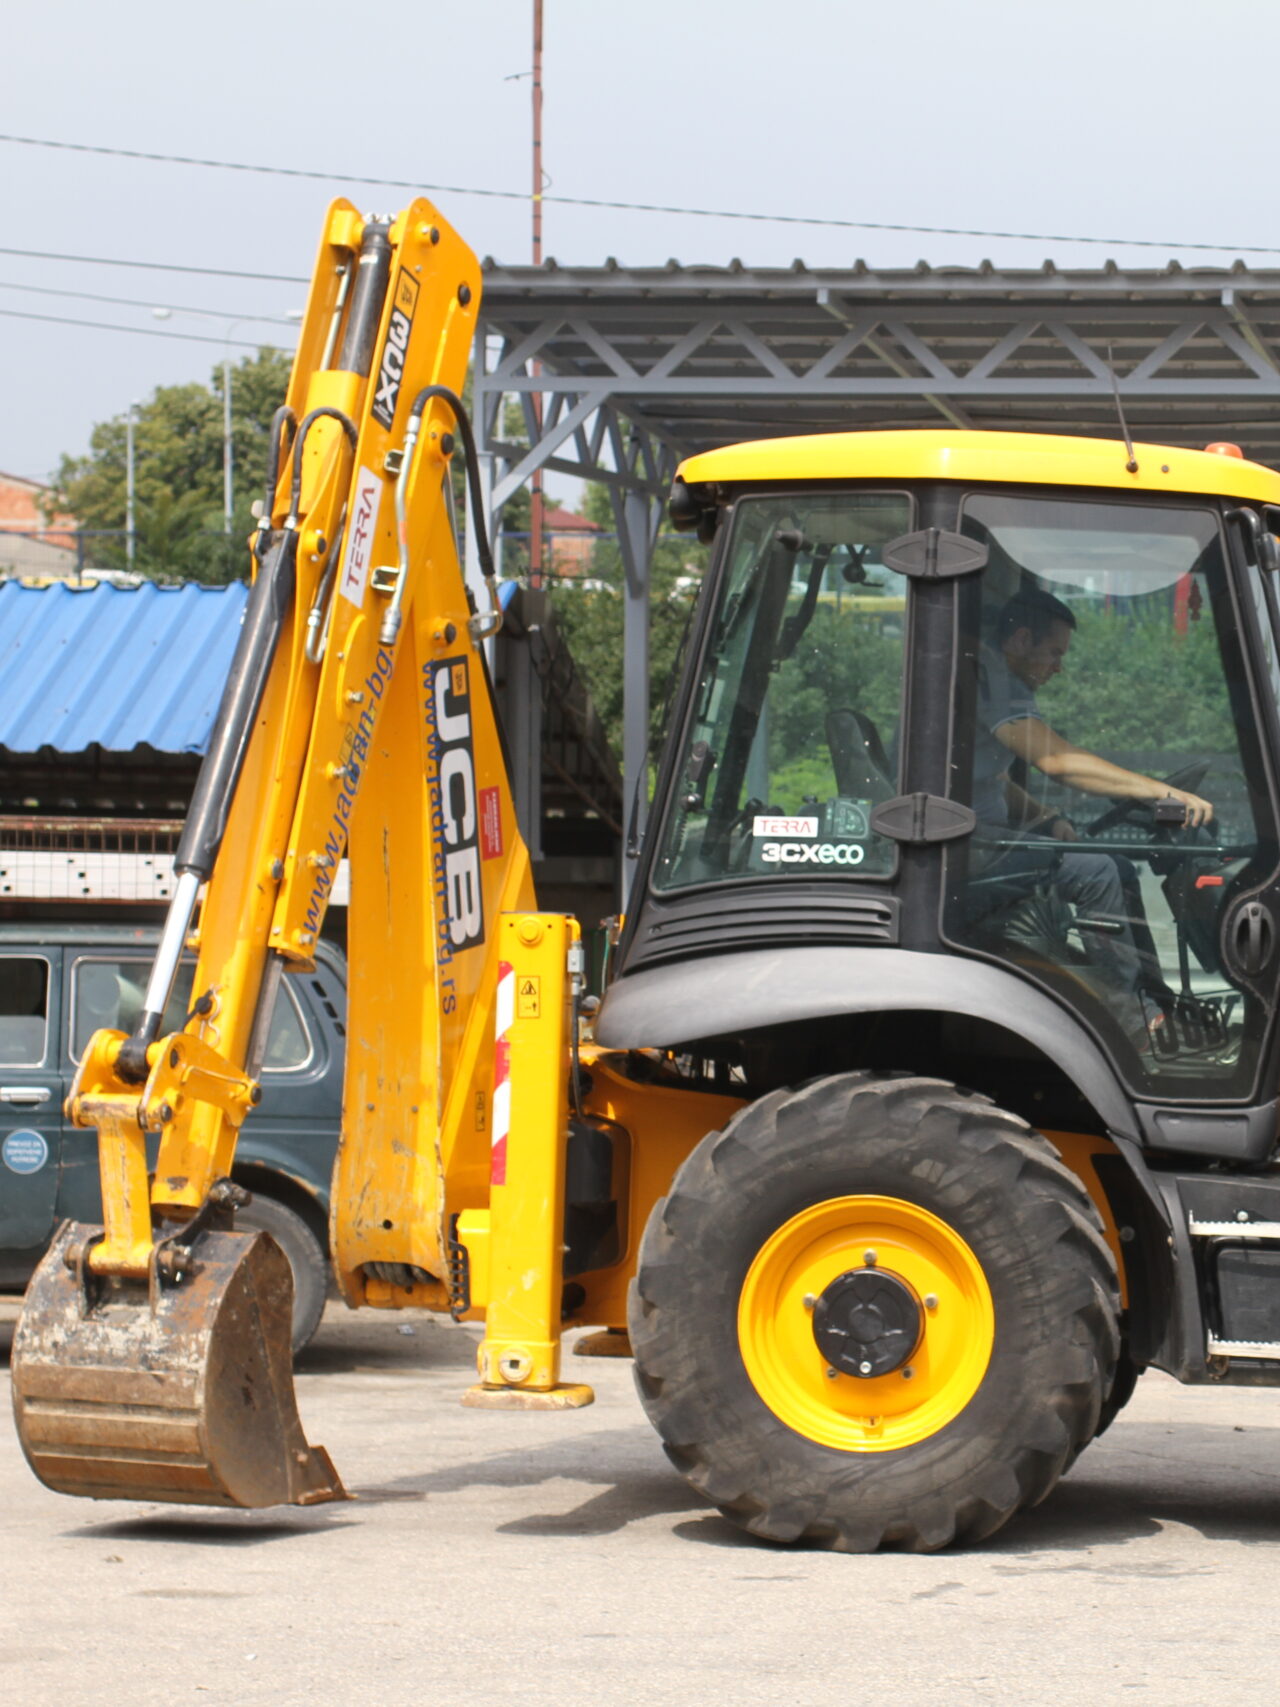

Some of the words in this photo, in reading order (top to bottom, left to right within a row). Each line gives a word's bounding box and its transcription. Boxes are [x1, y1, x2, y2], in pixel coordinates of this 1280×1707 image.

[346, 488, 375, 587] TERRA
[435, 667, 481, 945] JCB
[761, 820, 811, 833] TERRA
[761, 842, 864, 865] 3CXeco
